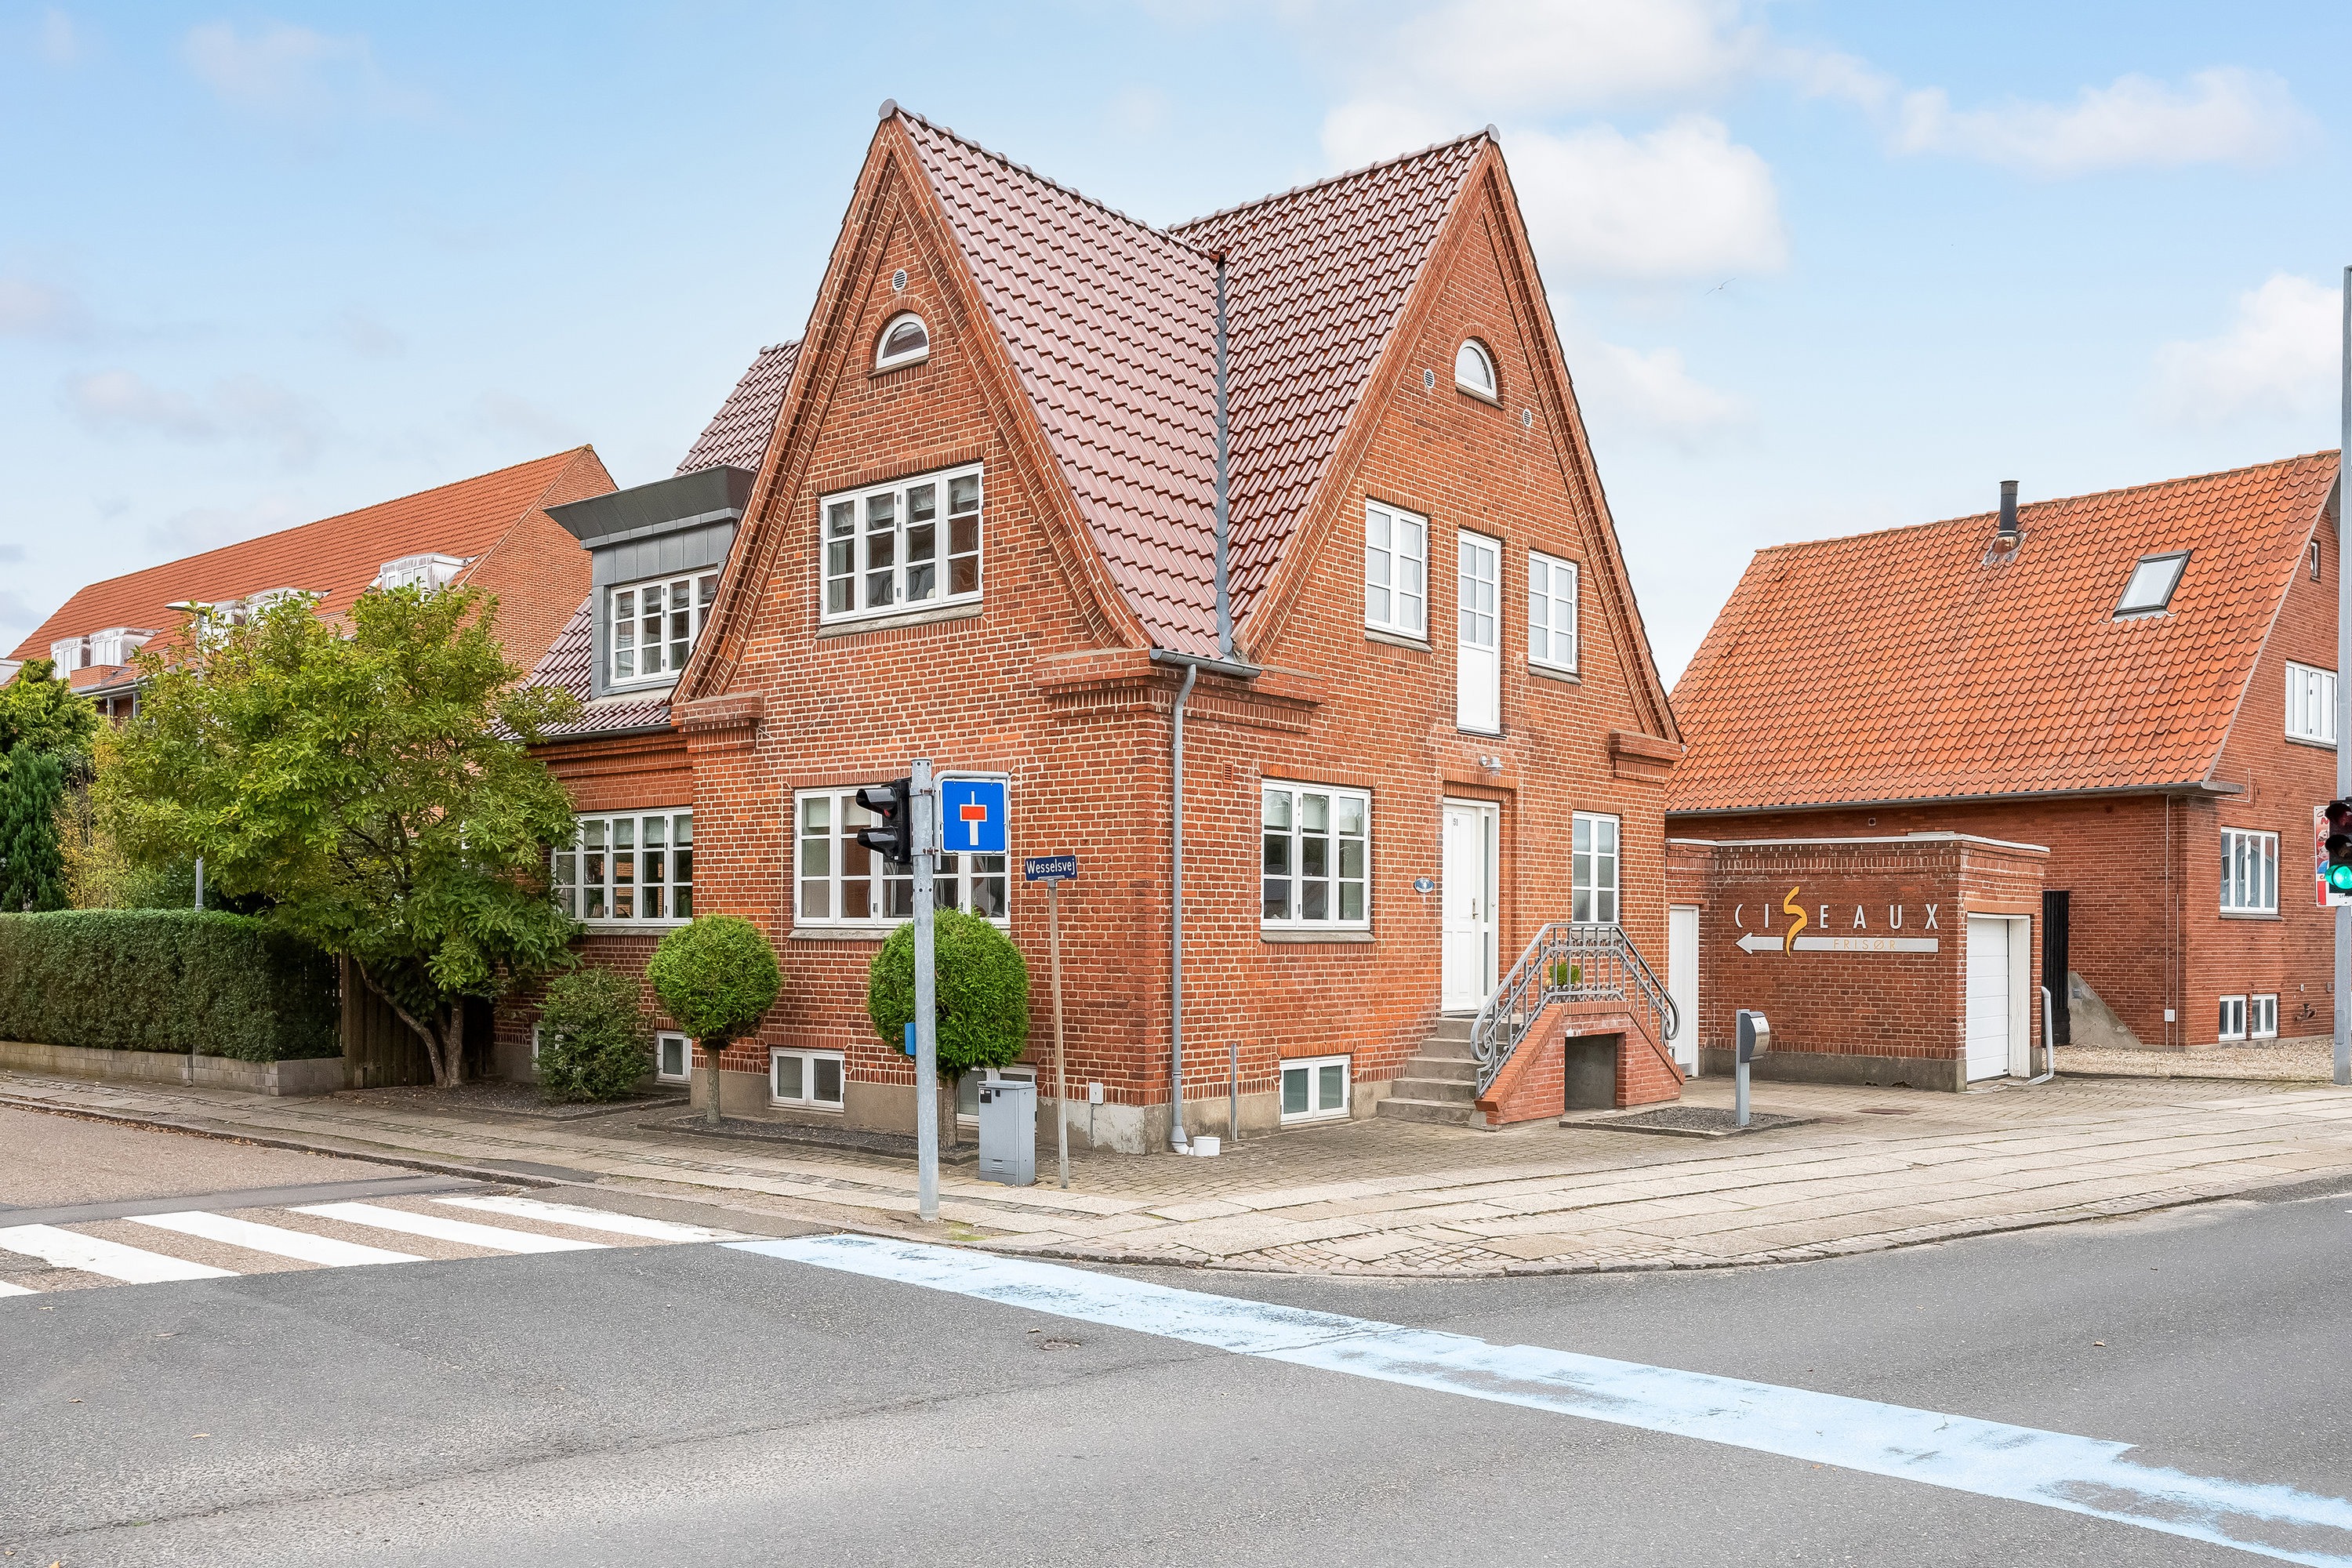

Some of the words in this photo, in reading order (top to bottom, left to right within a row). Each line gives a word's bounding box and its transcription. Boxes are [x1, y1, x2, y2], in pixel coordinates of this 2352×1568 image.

[1453, 818, 1458, 827] 51
[1025, 858, 1075, 876] Wesselsvej
[1734, 886, 1939, 957] CISEAUX
[1833, 938, 1896, 950] FRISØR
